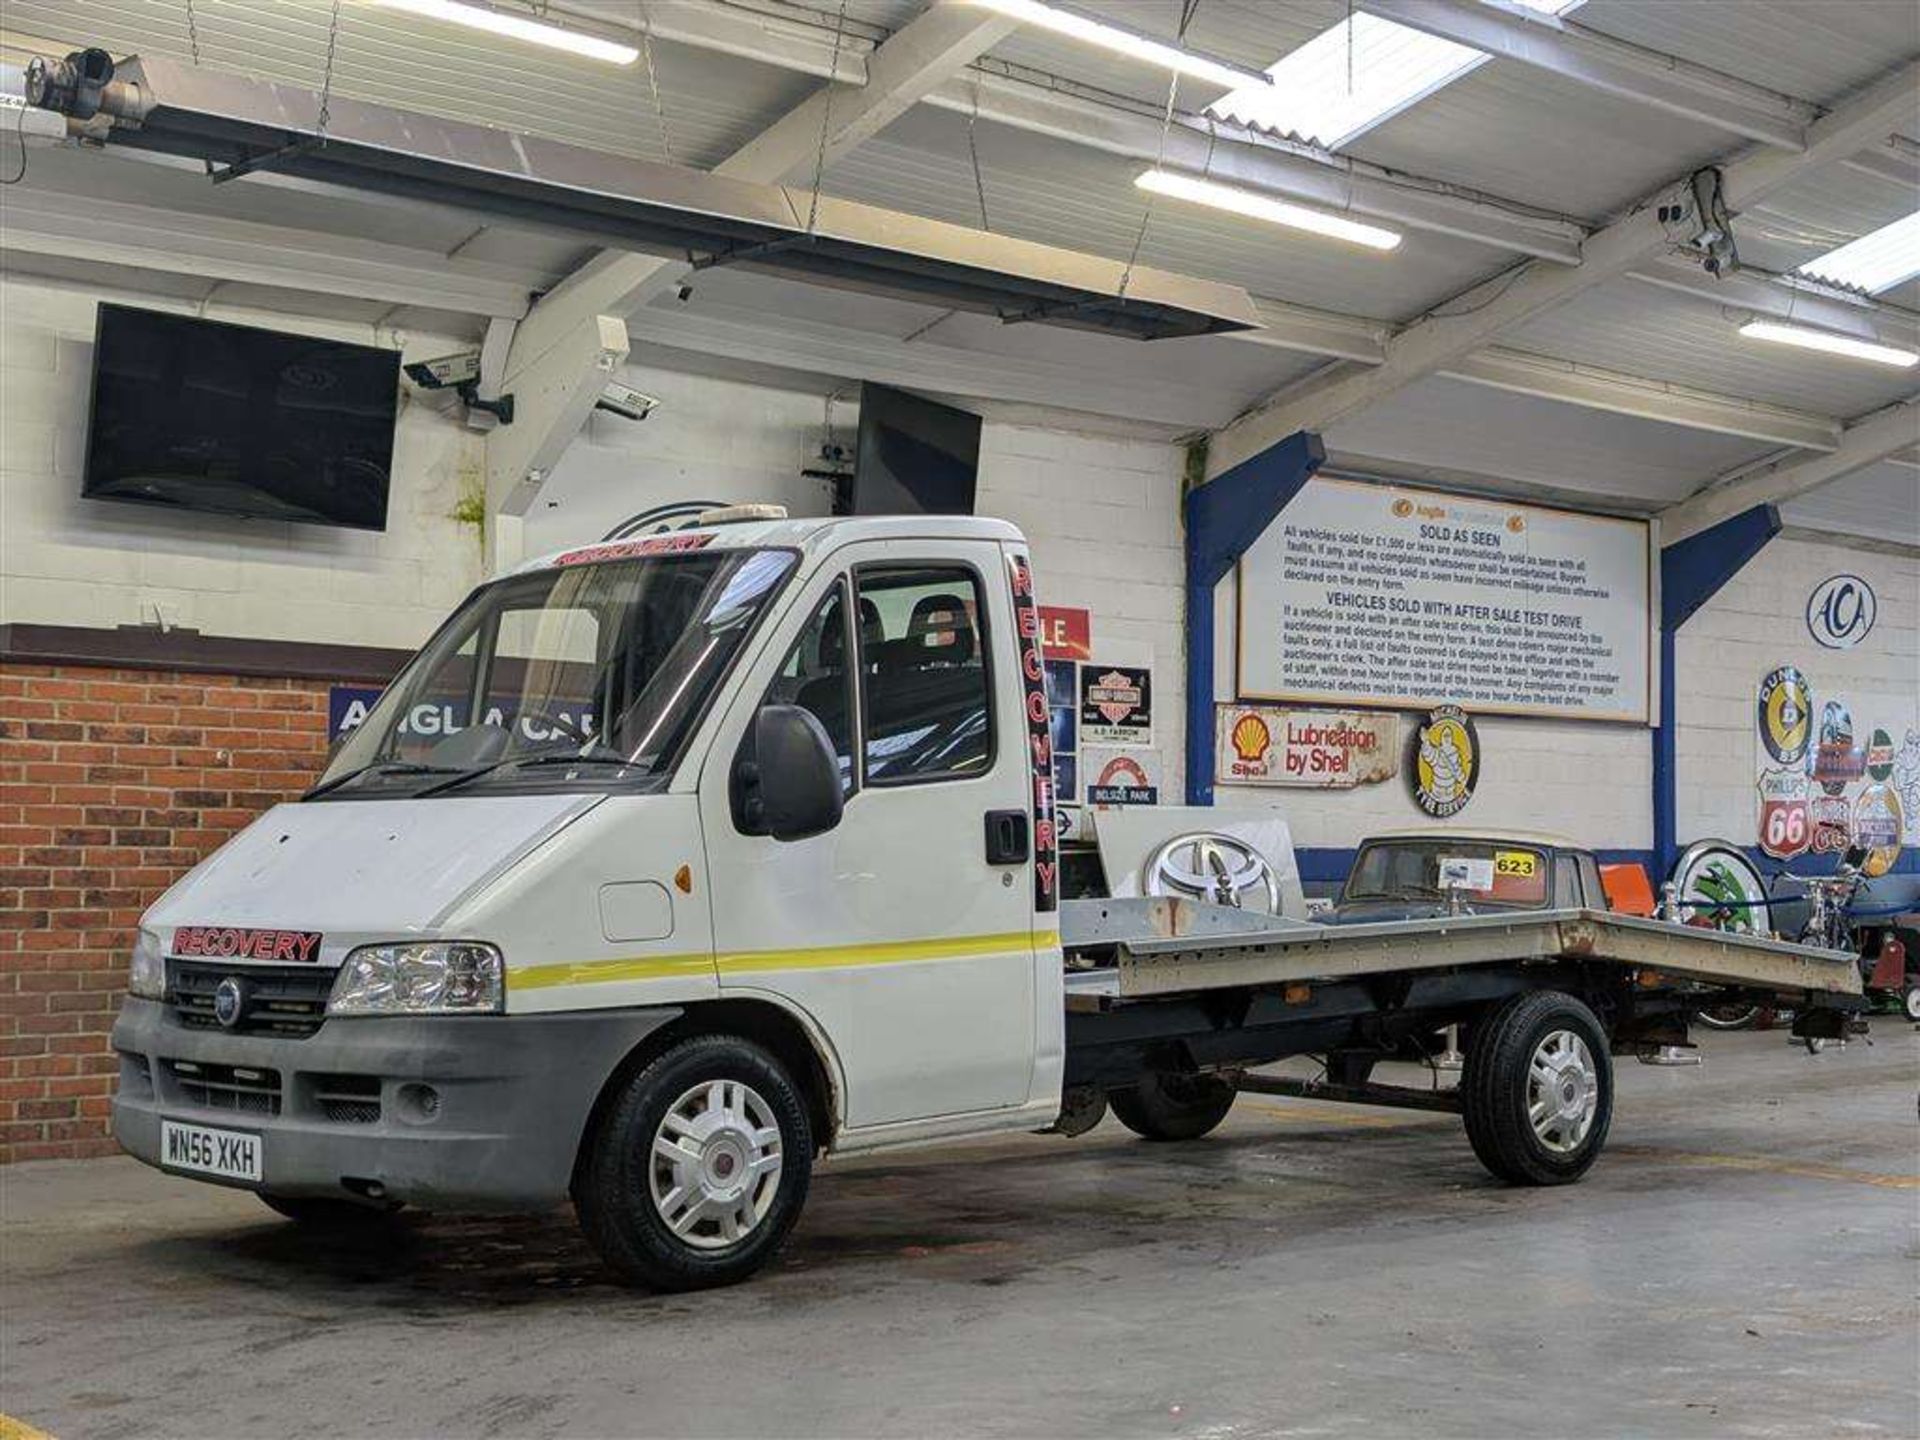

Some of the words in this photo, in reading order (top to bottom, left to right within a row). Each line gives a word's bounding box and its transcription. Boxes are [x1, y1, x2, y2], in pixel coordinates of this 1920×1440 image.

[1284, 526, 1296, 537] All
[1300, 528, 1336, 541] vehicles
[1339, 533, 1358, 544] sold
[1361, 535, 1374, 545] for
[1417, 542, 1434, 552] less
[1438, 546, 1450, 554] are
[1453, 547, 1506, 564] automatically
[1508, 554, 1525, 564] sold
[1539, 557, 1556, 567] seen
[1559, 559, 1574, 568] with
[1577, 561, 1585, 570] all
[1420, 524, 1450, 540] SOLD
[1454, 529, 1468, 542] AS
[1472, 530, 1500, 546] SEEN
[1284, 556, 1307, 566] must
[1310, 559, 1344, 570] assume
[1348, 562, 1358, 571] all
[1361, 563, 1397, 576] vehicles
[1400, 567, 1417, 578] sold
[1432, 572, 1451, 582] seen
[1454, 572, 1473, 584] have
[1475, 574, 1511, 588] incorrect
[1514, 579, 1544, 593] mileage
[1547, 584, 1571, 595] unless
[1573, 586, 1609, 599] otherwise
[1284, 569, 1323, 583] declared
[1326, 574, 1337, 583] on
[1341, 575, 1354, 585] the
[1357, 577, 1379, 589] entry
[1348, 549, 1363, 559] and
[1367, 551, 1377, 559] no
[1380, 551, 1426, 566] complaints
[1429, 556, 1476, 571] whatsoever
[1479, 562, 1497, 573] shall
[1500, 565, 1509, 574] be
[1560, 572, 1586, 584] Buyers
[1301, 608, 1333, 620] vehicle
[1346, 611, 1365, 622] sold
[1368, 614, 1386, 623] with
[1402, 617, 1420, 627] after
[1423, 619, 1440, 629] sale
[1442, 620, 1459, 631] test
[1485, 625, 1500, 634] this
[1503, 626, 1522, 636] shall
[1524, 628, 1534, 637] be
[1536, 629, 1577, 642] announced
[1580, 632, 1588, 645] by
[1591, 633, 1603, 644] the
[1327, 591, 1385, 610] VEHICLES
[1389, 598, 1420, 613] SOLD
[1423, 600, 1451, 615] WITH
[1455, 606, 1490, 620] AFTER
[1493, 608, 1520, 623] SALE
[1523, 611, 1548, 626] TEST
[1552, 614, 1582, 629] DRIVE
[1283, 633, 1309, 645] faults
[1344, 638, 1357, 649] full
[1360, 640, 1373, 650] list
[1388, 641, 1411, 653] faults
[1414, 644, 1447, 656] covered
[1459, 649, 1498, 662] displayed
[1510, 652, 1522, 662] the
[1525, 654, 1546, 664] office
[1549, 656, 1562, 666] and
[1565, 657, 1580, 666] with
[1583, 658, 1594, 668] the
[1284, 620, 1332, 633] auctioneer
[1335, 625, 1351, 635] and
[1354, 626, 1392, 639] declared
[1395, 631, 1405, 640] on
[1408, 631, 1420, 641] the
[1423, 633, 1444, 645] entry
[1470, 636, 1476, 645] A
[1479, 637, 1494, 647] test
[1496, 638, 1516, 649] drive
[1519, 641, 1544, 651] covers
[1547, 644, 1568, 654] major
[1571, 645, 1612, 657] mechanical
[1321, 666, 1348, 676] within
[1351, 669, 1367, 678] one
[1369, 669, 1389, 679] hour
[1392, 671, 1411, 681] from
[1414, 672, 1427, 682] the
[1455, 674, 1468, 685] the
[1507, 678, 1522, 690] Any
[1524, 680, 1566, 692] complaints
[1578, 685, 1591, 694] any
[1592, 686, 1613, 697] major
[1369, 654, 1385, 665] The
[1388, 655, 1407, 667] after
[1410, 658, 1426, 668] sale
[1429, 660, 1444, 670] test
[1447, 662, 1467, 673] drive
[1470, 664, 1490, 673] must
[1492, 664, 1502, 674] be
[1531, 667, 1563, 680] together
[1566, 670, 1580, 679] with
[1590, 672, 1619, 682] member
[1283, 676, 1335, 689] mechanical
[1338, 681, 1371, 693] defects
[1373, 683, 1395, 694] must
[1397, 685, 1408, 694] be
[1410, 686, 1446, 698] reported
[1449, 687, 1473, 698] within
[1476, 689, 1490, 699] one
[1492, 690, 1511, 700] hour
[1513, 692, 1531, 701] from
[1534, 692, 1546, 702] the
[1548, 694, 1562, 704] test
[339, 697, 504, 736] AGLA
[1013, 565, 1056, 895] RECOVERY
[1286, 722, 1376, 748] Lubrication
[1286, 749, 1308, 775] by
[1310, 749, 1349, 773] Shell
[1096, 789, 1127, 801] BELSIZE
[1130, 790, 1151, 801] PARK
[1767, 807, 1804, 846] 66
[1497, 859, 1533, 874] 623
[173, 927, 321, 961] RECOVERY
[168, 1127, 213, 1167] WN56
[217, 1135, 254, 1174] XKH
